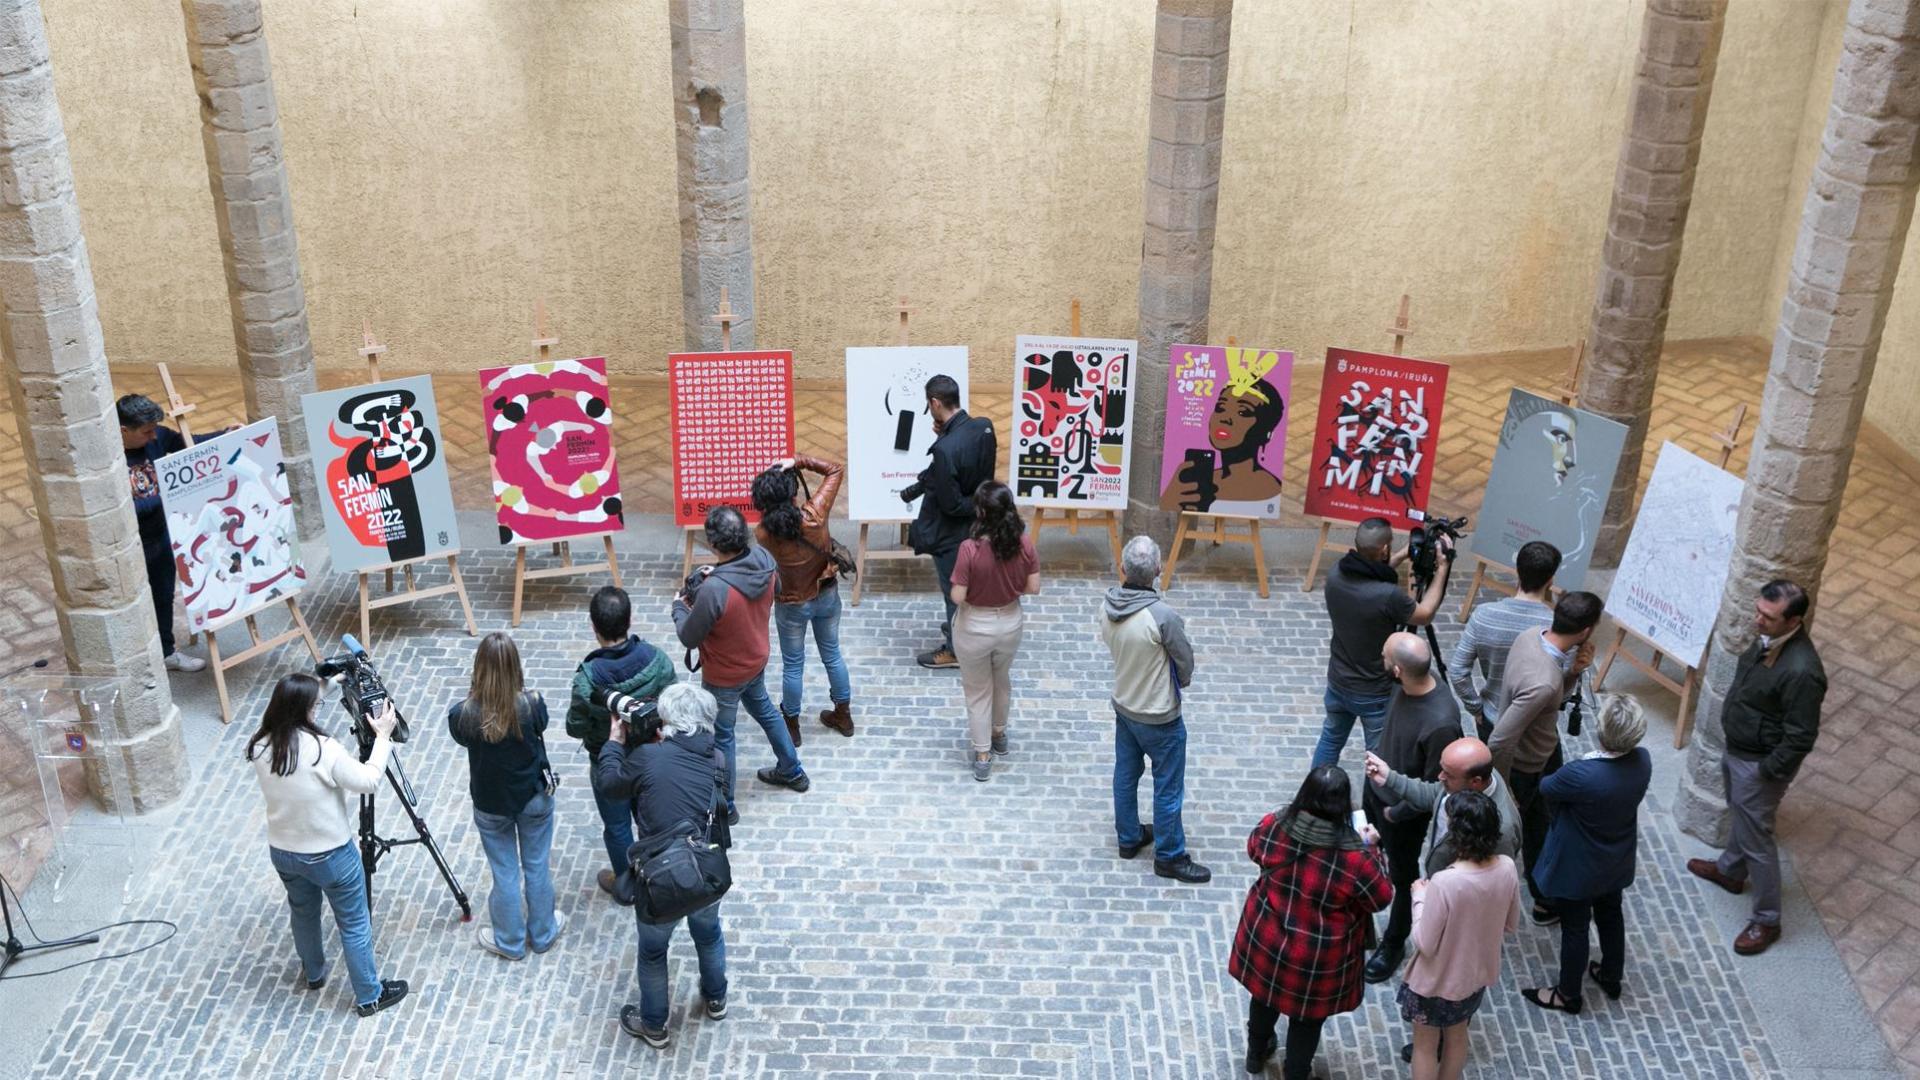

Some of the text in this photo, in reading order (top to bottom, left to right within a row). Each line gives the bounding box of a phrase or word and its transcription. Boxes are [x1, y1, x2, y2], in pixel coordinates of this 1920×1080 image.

[1177, 379, 1214, 397] 2022
[1340, 381, 1424, 418] SAN
[161, 459, 182, 472] SAN
[164, 454, 222, 491] 2022
[337, 472, 372, 500] SAN
[366, 508, 404, 531] 2022
